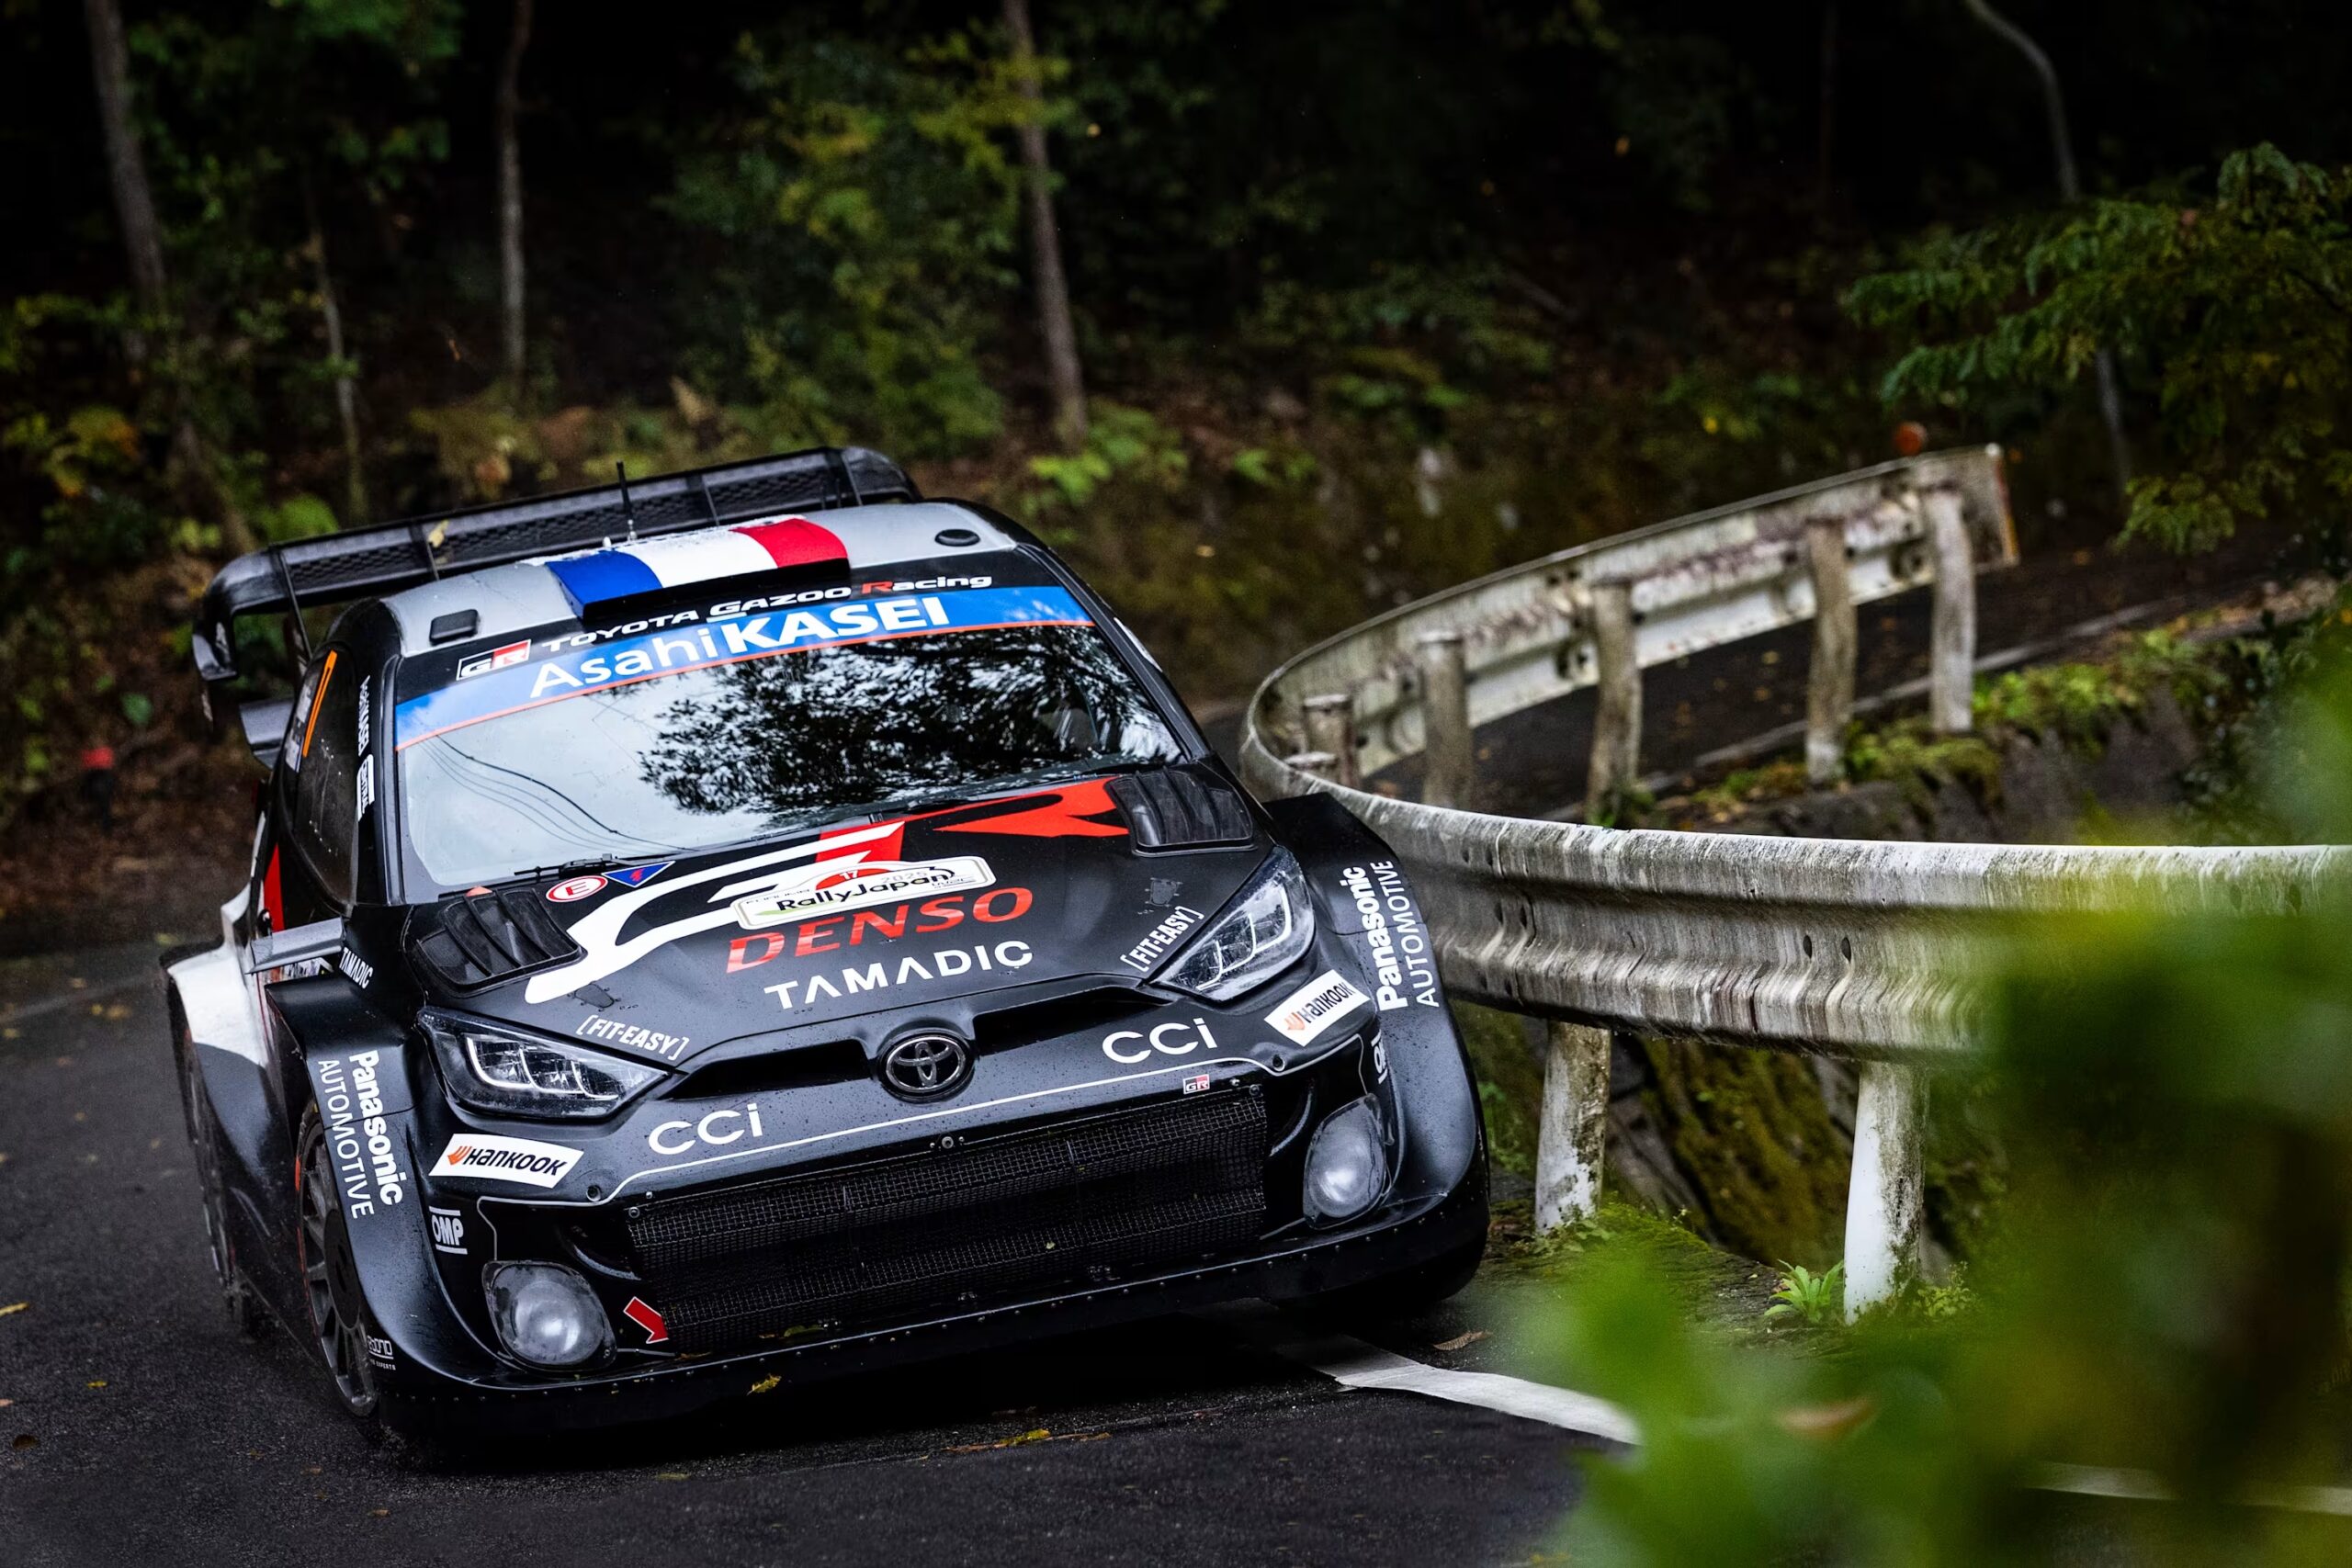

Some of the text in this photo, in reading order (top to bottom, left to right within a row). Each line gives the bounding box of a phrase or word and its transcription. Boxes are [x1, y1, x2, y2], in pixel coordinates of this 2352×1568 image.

[459, 575, 993, 679] GR TOYOTA GAZOO Racing
[565, 881, 590, 897] E
[839, 869, 859, 881] 17
[880, 871, 928, 884] 2025
[725, 886, 1034, 974] DENSO
[1339, 866, 1409, 1011] Panasonic
[1369, 860, 1440, 1008] AUTOMOTIVE
[338, 946, 374, 990] TAMADIC
[763, 940, 1034, 1010] TAMADIC
[1184, 1077, 1209, 1093] GR
[318, 1059, 375, 1219] AUTOMOTIVE
[348, 1050, 408, 1206] Panasonic
[431, 1214, 464, 1246] OMP
